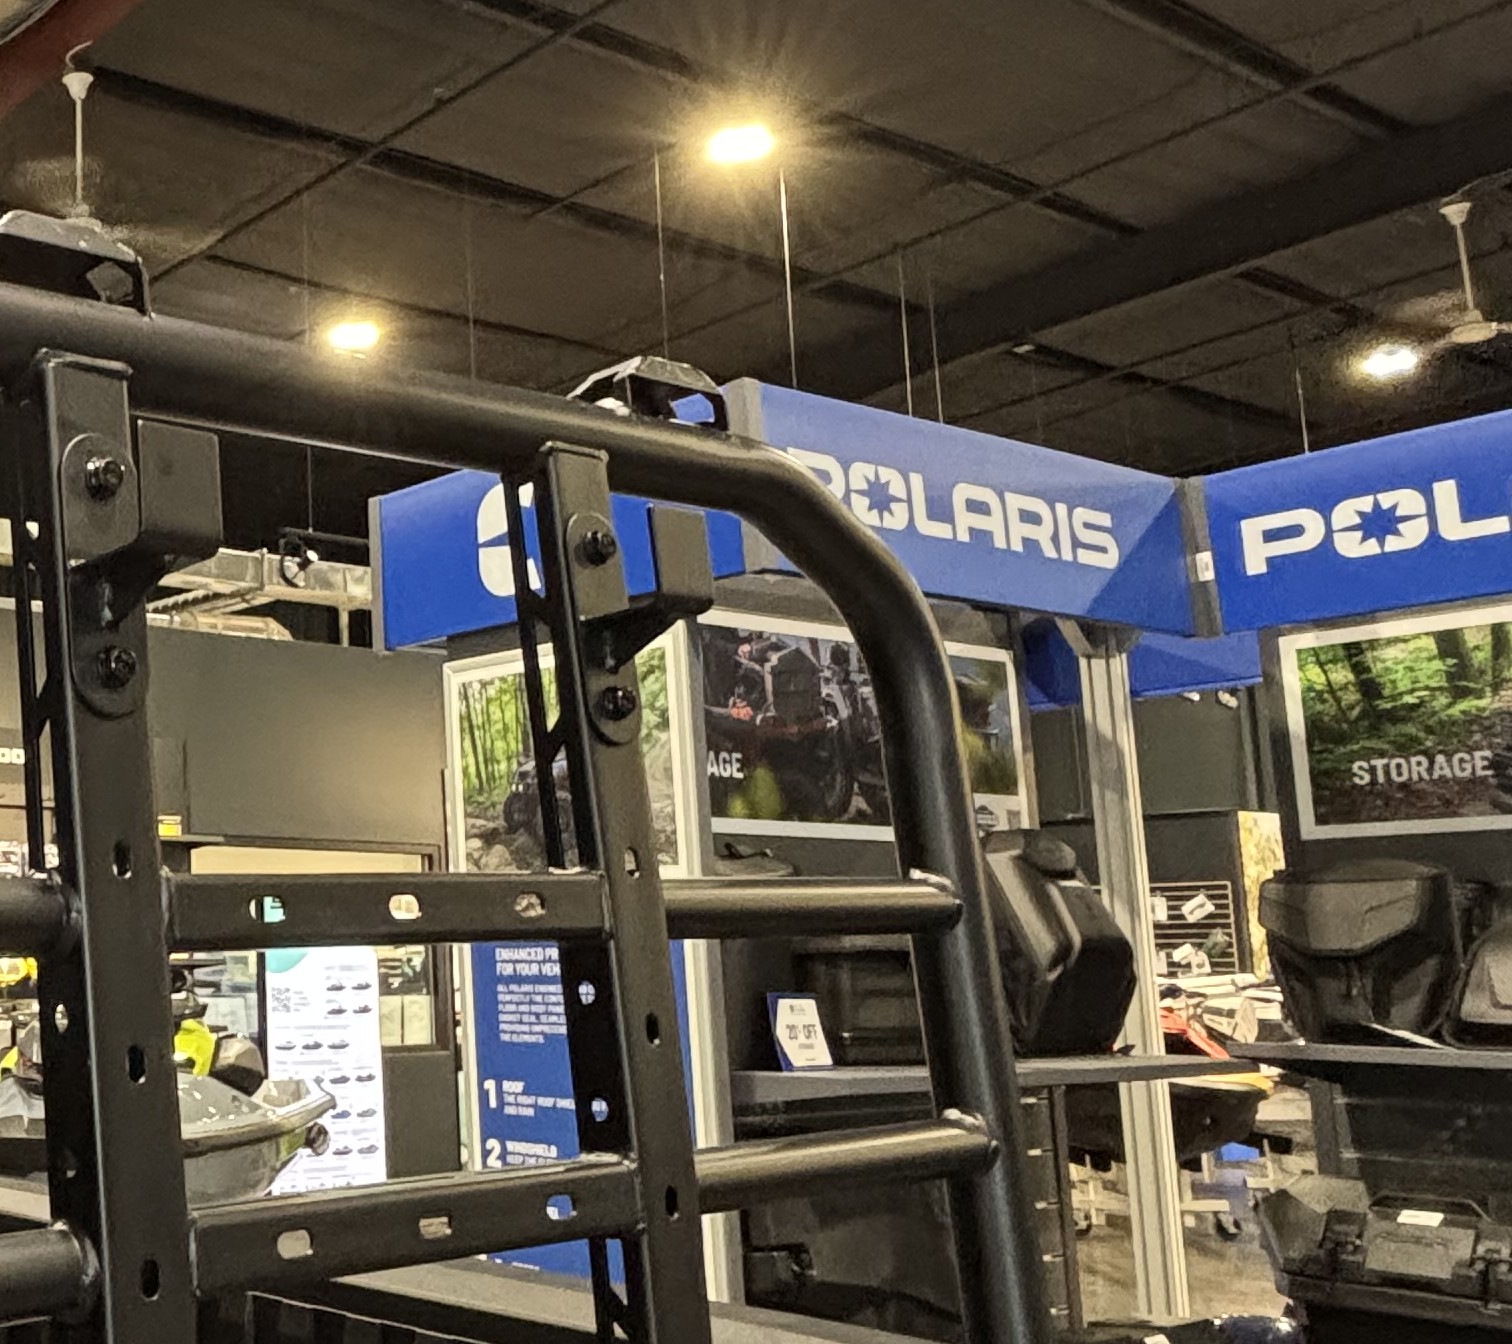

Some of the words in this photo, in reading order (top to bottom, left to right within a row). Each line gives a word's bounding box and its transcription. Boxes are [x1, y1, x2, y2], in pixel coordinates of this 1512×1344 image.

[787, 446, 1121, 570] POLARIS
[1239, 478, 1511, 577] POL
[1351, 750, 1496, 787] STORAGE
[495, 947, 544, 962] ENHANCED
[496, 962, 514, 976] FOR
[515, 962, 540, 977] YOUR
[483, 1078, 497, 1109] 1
[485, 1138, 503, 1169] 2
